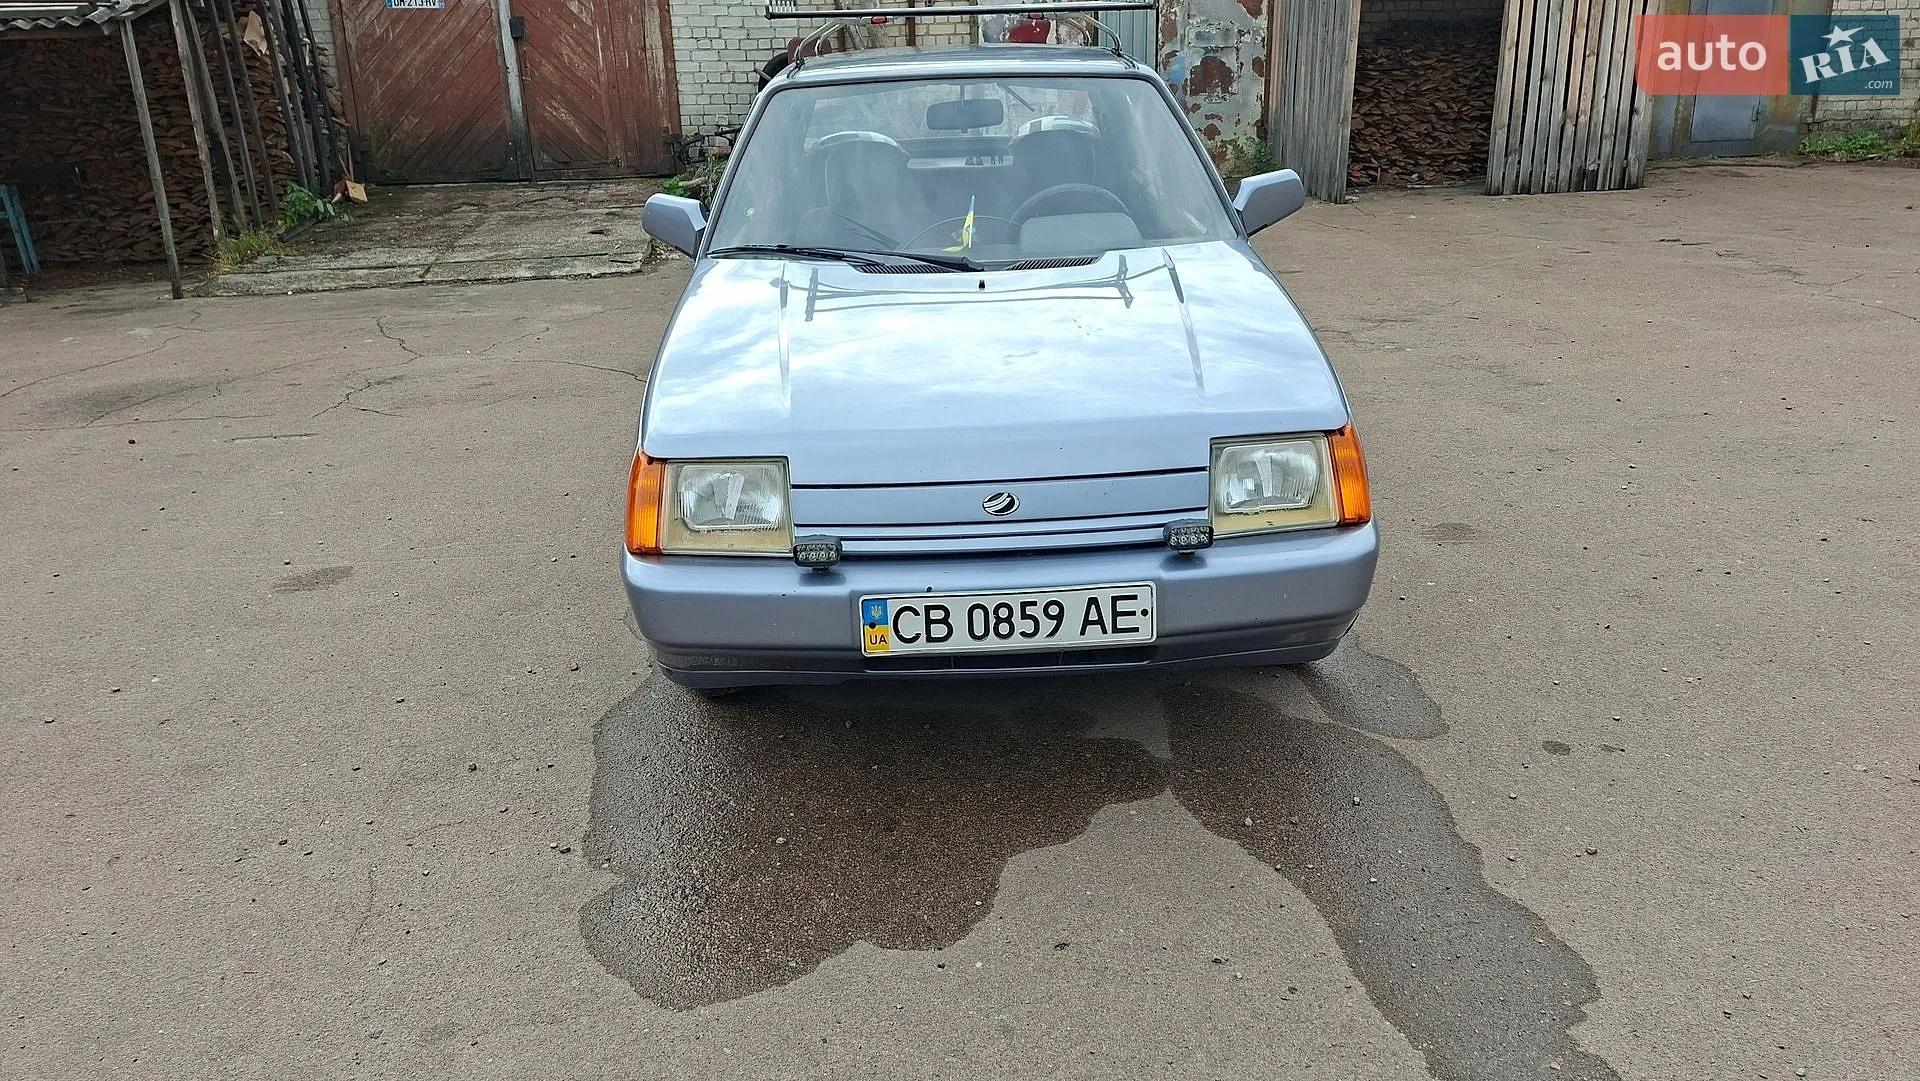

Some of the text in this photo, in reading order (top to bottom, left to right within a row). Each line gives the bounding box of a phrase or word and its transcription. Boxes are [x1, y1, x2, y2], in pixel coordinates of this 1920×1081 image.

[892, 594, 1140, 645] CB 0859 AE
[869, 633, 888, 646] UA
